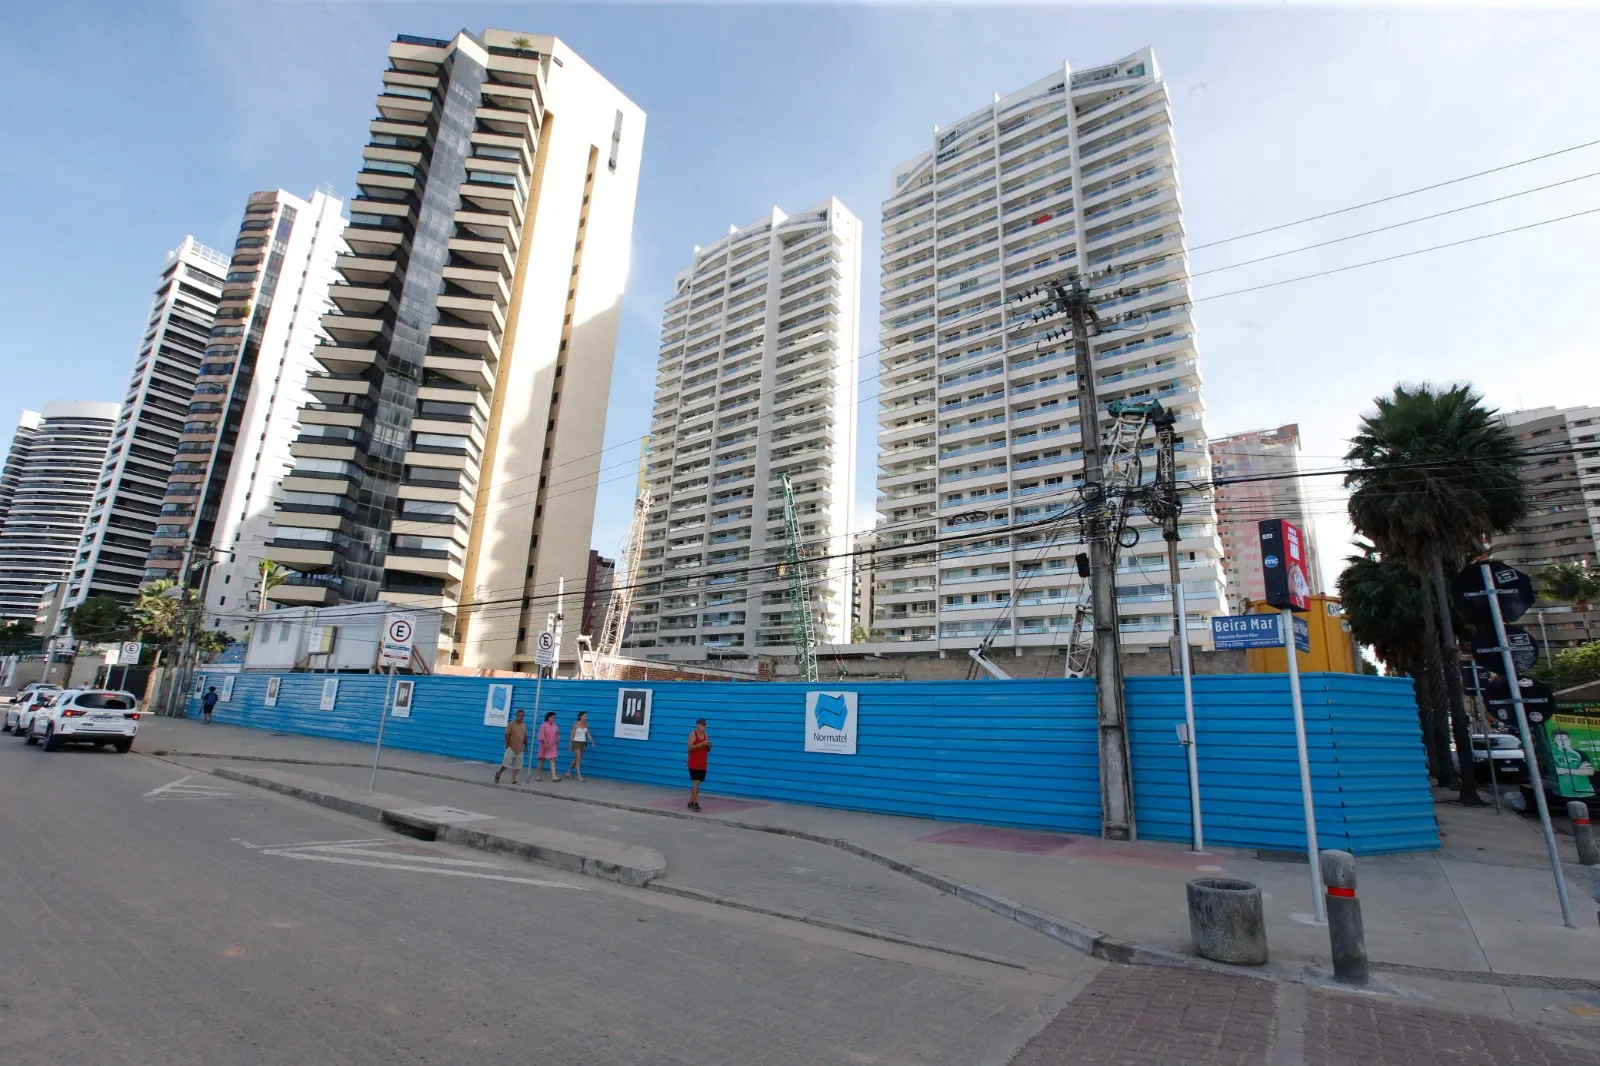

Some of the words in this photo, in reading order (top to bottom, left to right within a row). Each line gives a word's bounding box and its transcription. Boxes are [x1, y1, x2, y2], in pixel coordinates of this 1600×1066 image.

[396, 625, 405, 637] E
[1215, 619, 1247, 632] Beira
[1251, 619, 1273, 630] Mar
[813, 732, 848, 743] Normatel
